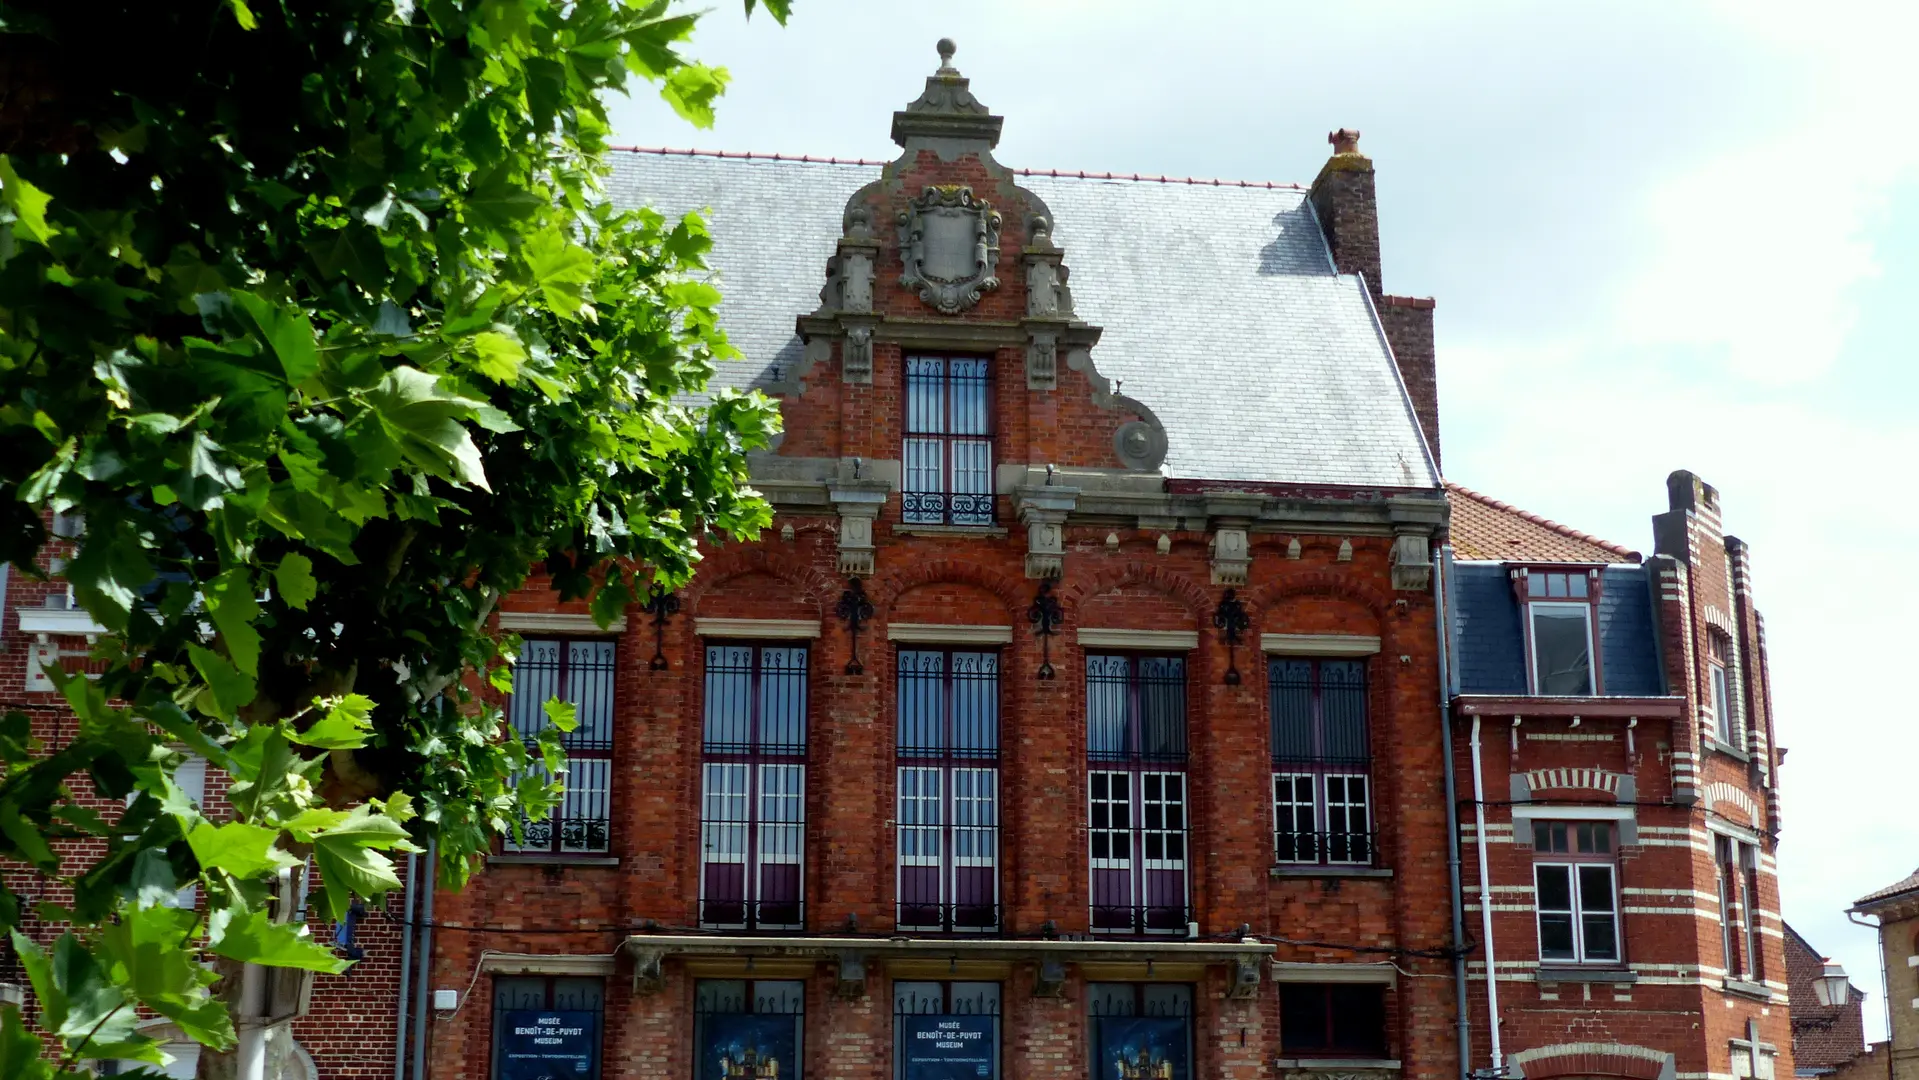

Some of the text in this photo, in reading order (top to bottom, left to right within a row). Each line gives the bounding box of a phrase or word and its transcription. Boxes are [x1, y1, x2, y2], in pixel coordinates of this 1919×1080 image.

[538, 1017, 561, 1025] MUSÉE
[938, 1021, 961, 1029] MUSÉE
[534, 1037, 563, 1045] MUSEUM
